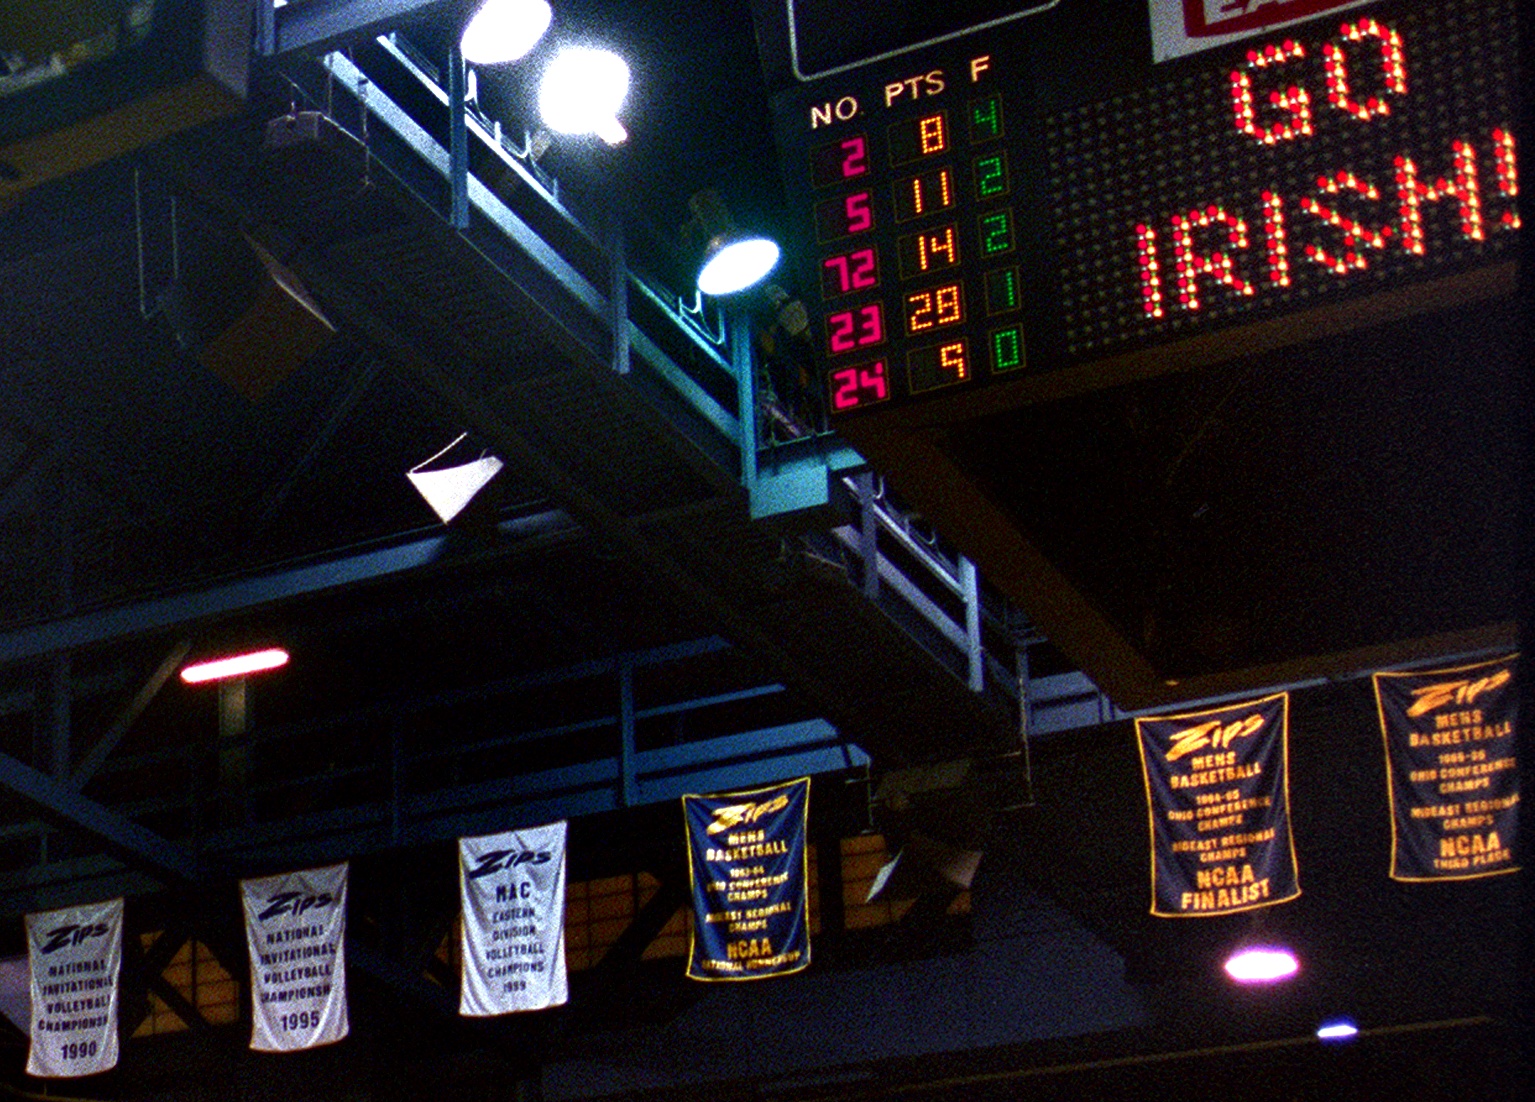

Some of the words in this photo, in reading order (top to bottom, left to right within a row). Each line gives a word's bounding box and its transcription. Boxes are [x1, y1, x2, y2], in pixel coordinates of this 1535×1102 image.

[811, 96, 858, 129] NO
[885, 70, 945, 107] PTS
[970, 56, 990, 82] F
[1230, 18, 1408, 146] GO
[841, 137, 866, 178] 2
[919, 115, 944, 154] 8
[974, 100, 997, 134] 4
[846, 192, 872, 233] 5
[913, 171, 950, 214] 11
[979, 157, 1003, 195] 2
[1135, 127, 1523, 320] IRISH!
[824, 248, 876, 292] 72
[918, 228, 955, 271] 14
[983, 214, 1009, 253] 2
[830, 304, 882, 353] 23
[909, 285, 961, 332] 28
[1005, 271, 1015, 307] 1
[833, 361, 887, 409] 24
[941, 343, 966, 379] 9
[995, 329, 1020, 368] 0
[1435, 709, 1484, 729] MENS
[1408, 720, 1512, 748] BASKETBALL
[1191, 751, 1237, 771] MENS
[1170, 761, 1263, 789] BASKETBALL
[1410, 769, 1438, 782] OHIO
[1439, 776, 1491, 794] CHAMPS
[1167, 810, 1195, 821] OHIO
[1410, 803, 1461, 819] MIDEAST
[1197, 813, 1244, 832] CHAMPS
[1443, 814, 1495, 831] CHAMPS
[728, 828, 766, 846] MENS
[1172, 838, 1218, 852] MIDEAST
[1221, 827, 1276, 847] REGIONAL
[1440, 830, 1501, 858] NCAA
[706, 840, 789, 862] BASKETBALL
[1199, 847, 1247, 863] CHAMPS
[1196, 864, 1255, 890] NCAA
[495, 881, 531, 903] MAC
[727, 888, 768, 902] CHAMPS
[1181, 877, 1270, 911] FINALIST
[492, 907, 536, 925] EASTERN
[728, 919, 768, 933] CHAMPS
[266, 924, 325, 945] NATIONAL
[492, 924, 536, 942] DIVISION
[260, 943, 337, 966] INVITATIONAL
[486, 943, 545, 961] VOLLEYBALL
[727, 937, 773, 959] NCAA
[48, 959, 107, 977] NATIONAL
[264, 964, 332, 984] VOLLEYBALL
[487, 961, 545, 979] CHAMPIONS
[43, 975, 114, 997] INVITATIONAL
[281, 1010, 321, 1032] 1995
[61, 1041, 98, 1060] 1990
